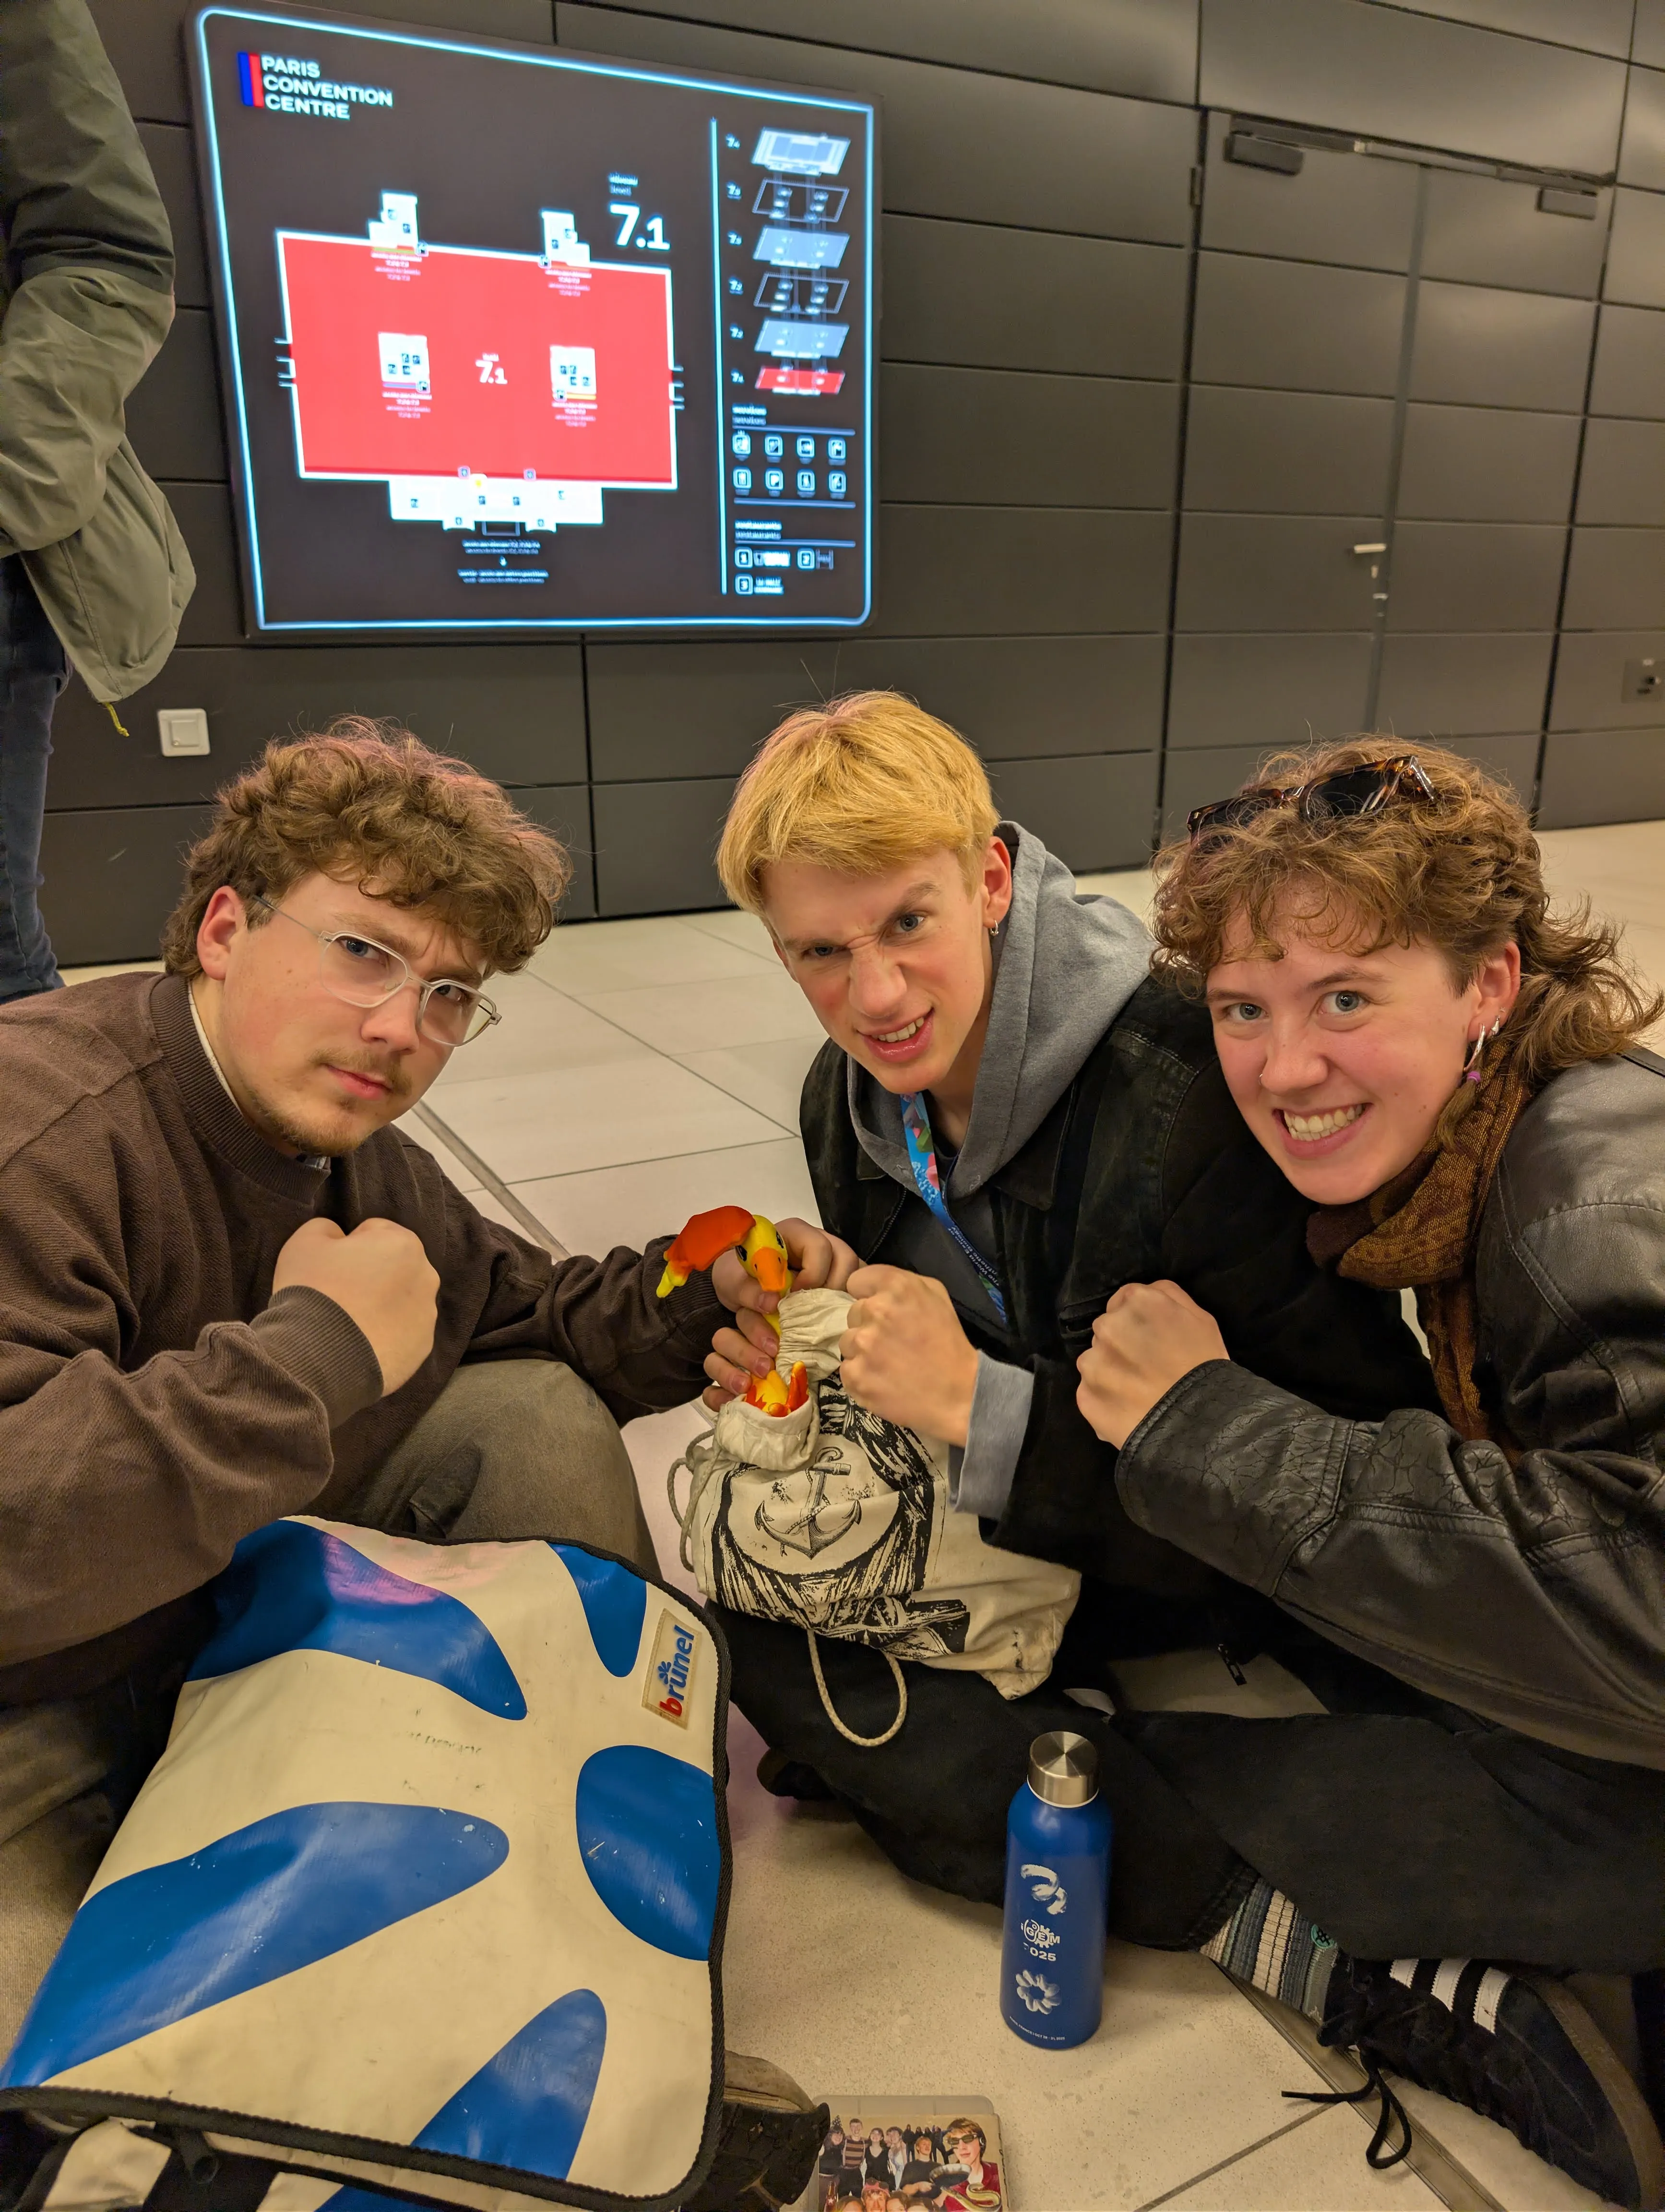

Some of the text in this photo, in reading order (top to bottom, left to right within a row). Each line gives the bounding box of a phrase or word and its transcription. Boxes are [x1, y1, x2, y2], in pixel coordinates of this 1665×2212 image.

[261, 54, 321, 78] PARIS
[263, 74, 393, 108] CONVENTION
[265, 93, 350, 120] CENTRE
[610, 203, 670, 251] 7.1
[475, 359, 508, 384] 7.1
[951, 1227, 998, 1275] nthetic Biology
[955, 1236, 970, 1254] Expo
[969, 1255, 987, 1275] World
[1018, 2024, 1033, 2035] FRANCE
